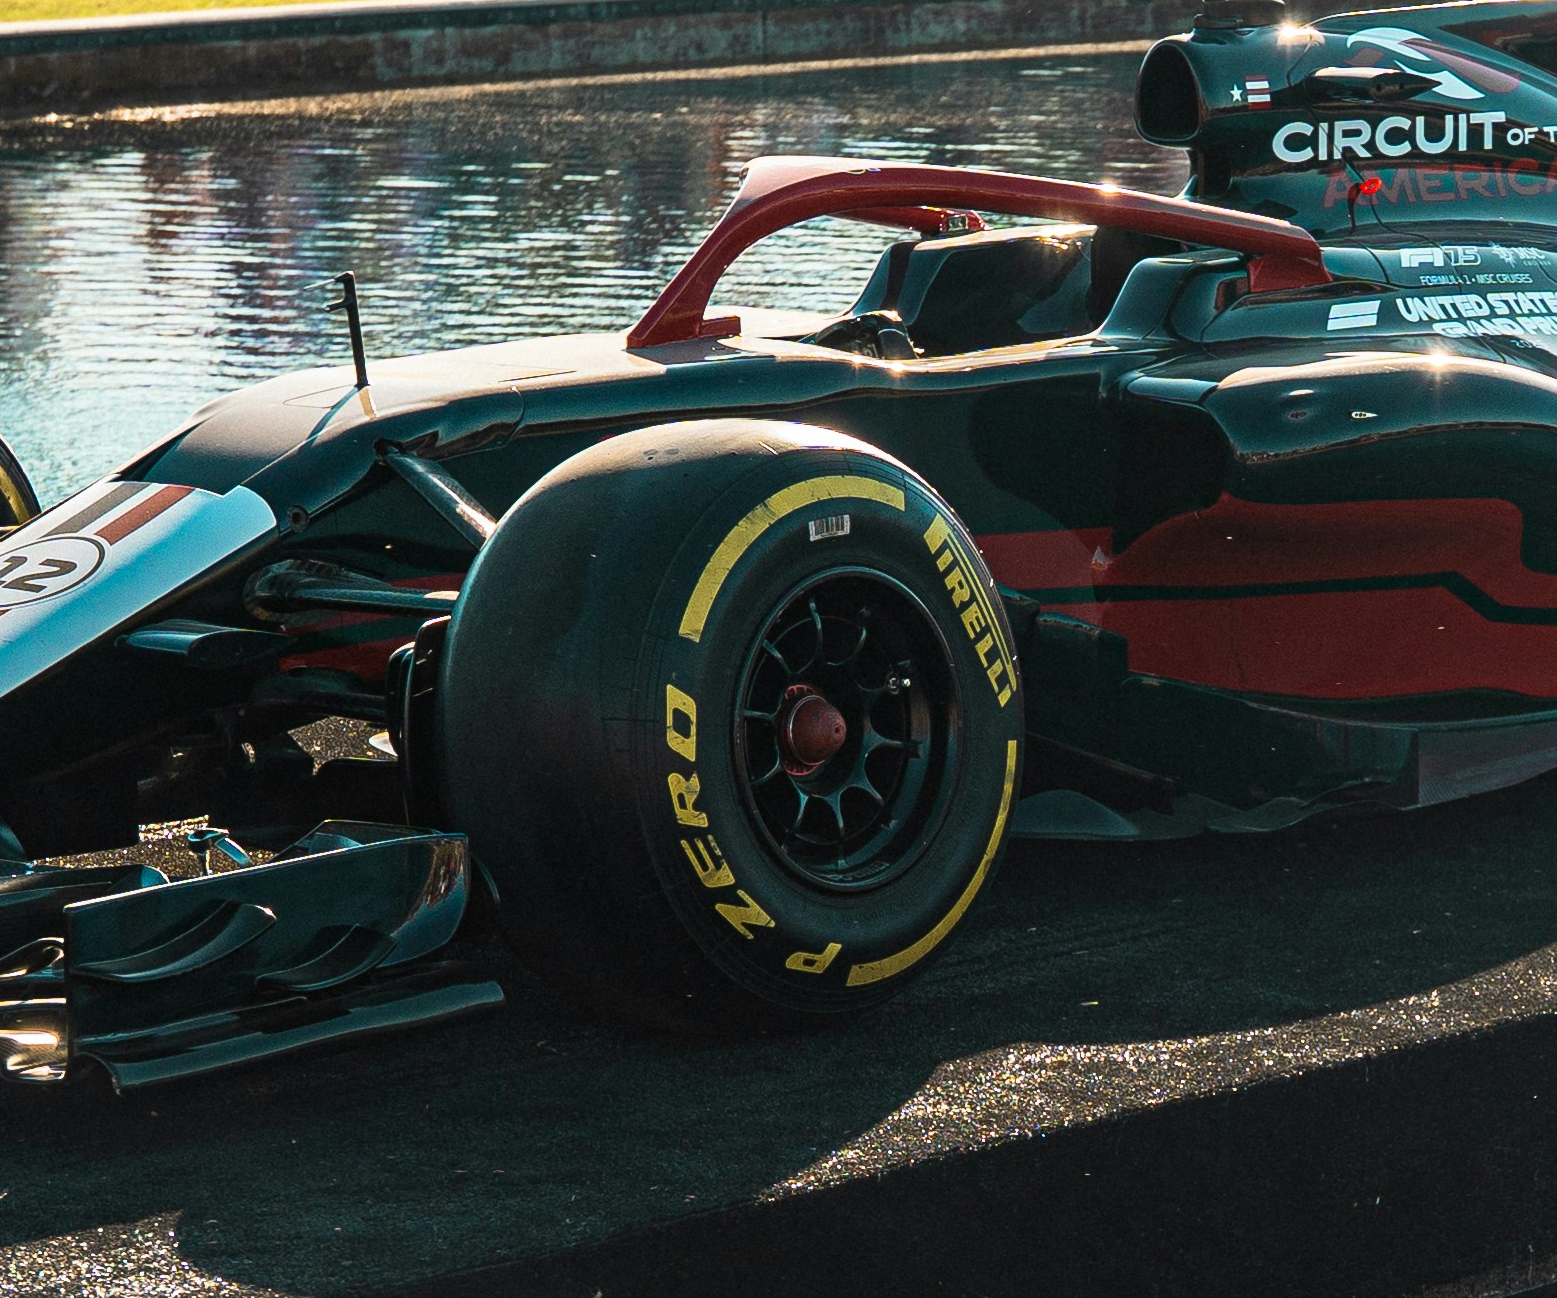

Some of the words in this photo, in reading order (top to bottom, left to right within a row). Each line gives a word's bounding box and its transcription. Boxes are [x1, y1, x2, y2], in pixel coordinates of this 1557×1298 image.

[1270, 110, 1508, 164] CIRCUIT
[1505, 126, 1541, 147] OF
[1419, 275, 1462, 286] FORMULA
[1475, 273, 1496, 285] MSC
[1495, 273, 1534, 285] CRUISES
[1396, 293, 1491, 324] UNITED
[1431, 316, 1526, 339] GRAND
[923, 511, 1017, 708] PIRELLI
[665, 683, 777, 940] ZERO
[785, 942, 843, 975] P
